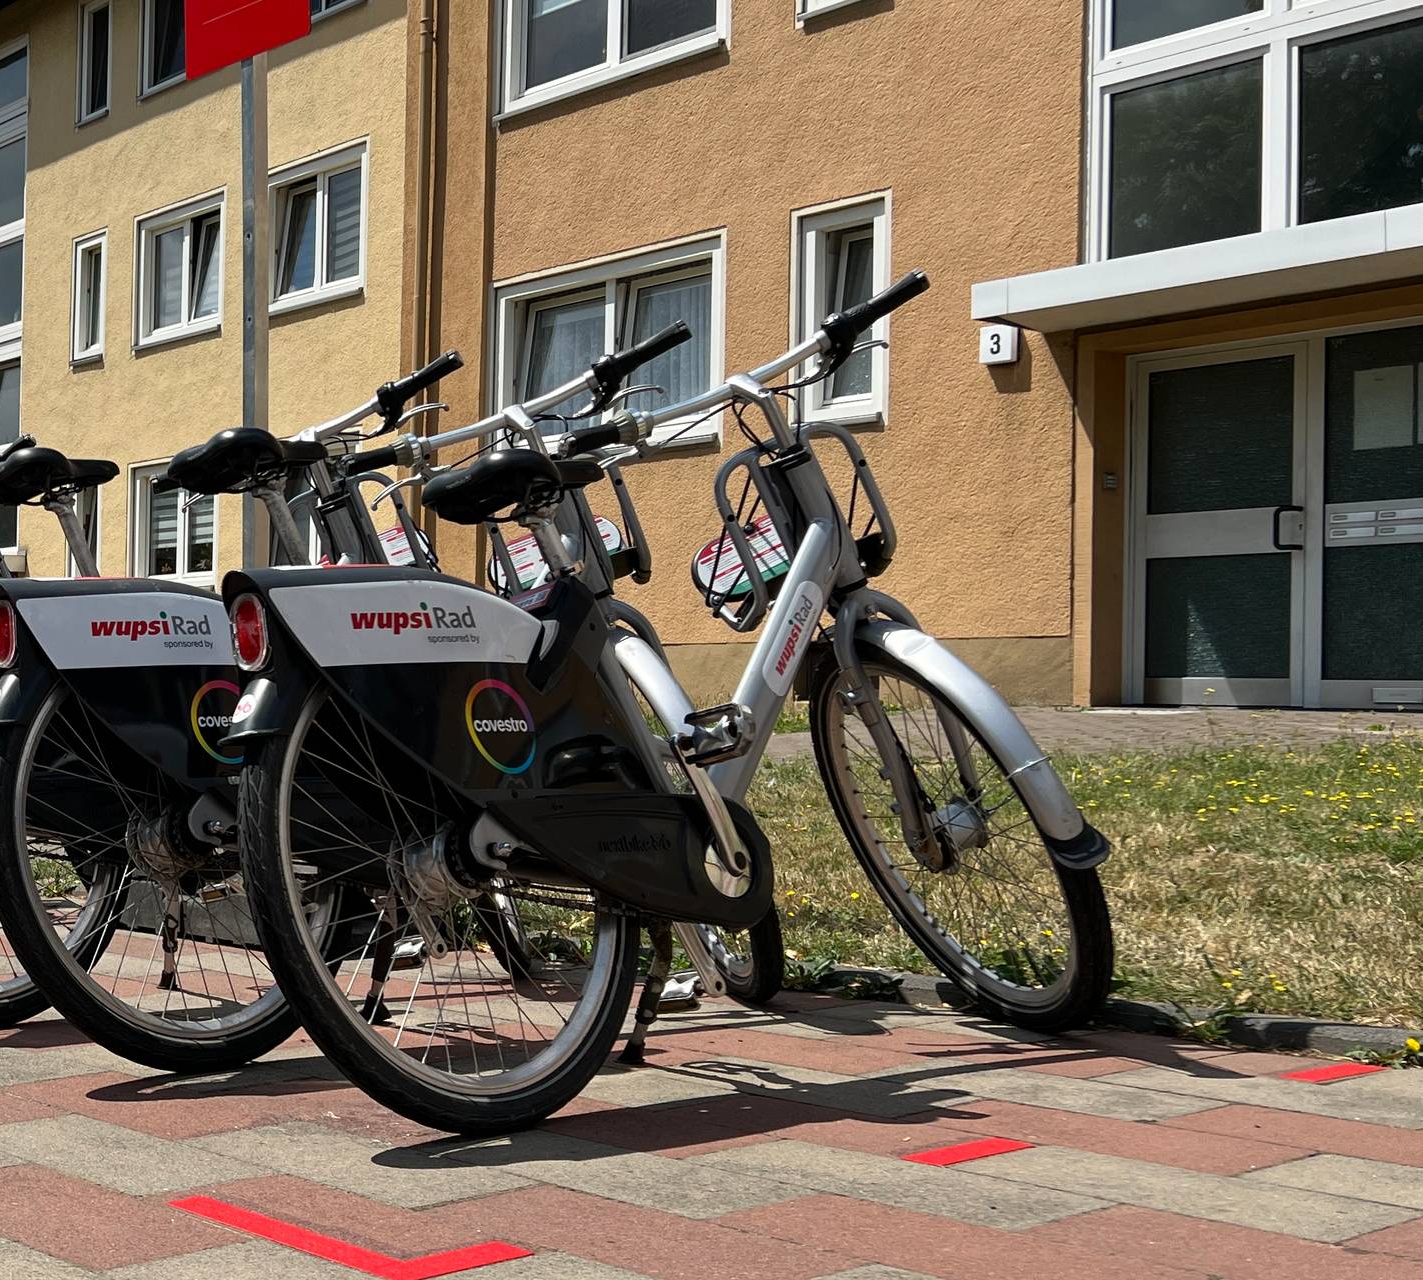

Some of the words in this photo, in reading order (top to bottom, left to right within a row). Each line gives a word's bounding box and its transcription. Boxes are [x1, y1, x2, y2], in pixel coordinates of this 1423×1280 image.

[990, 333, 1000, 354] 3
[91, 611, 170, 641] wupsi
[171, 614, 211, 635] Rad
[351, 602, 433, 635] wupsi
[433, 606, 477, 629] Rad
[164, 640, 203, 648] sponsored
[205, 640, 214, 649] by
[428, 634, 469, 643] sponsored
[471, 634, 479, 644] by
[776, 619, 802, 676] wupsi
[794, 595, 813, 626] Rad
[473, 717, 527, 732] covestro
